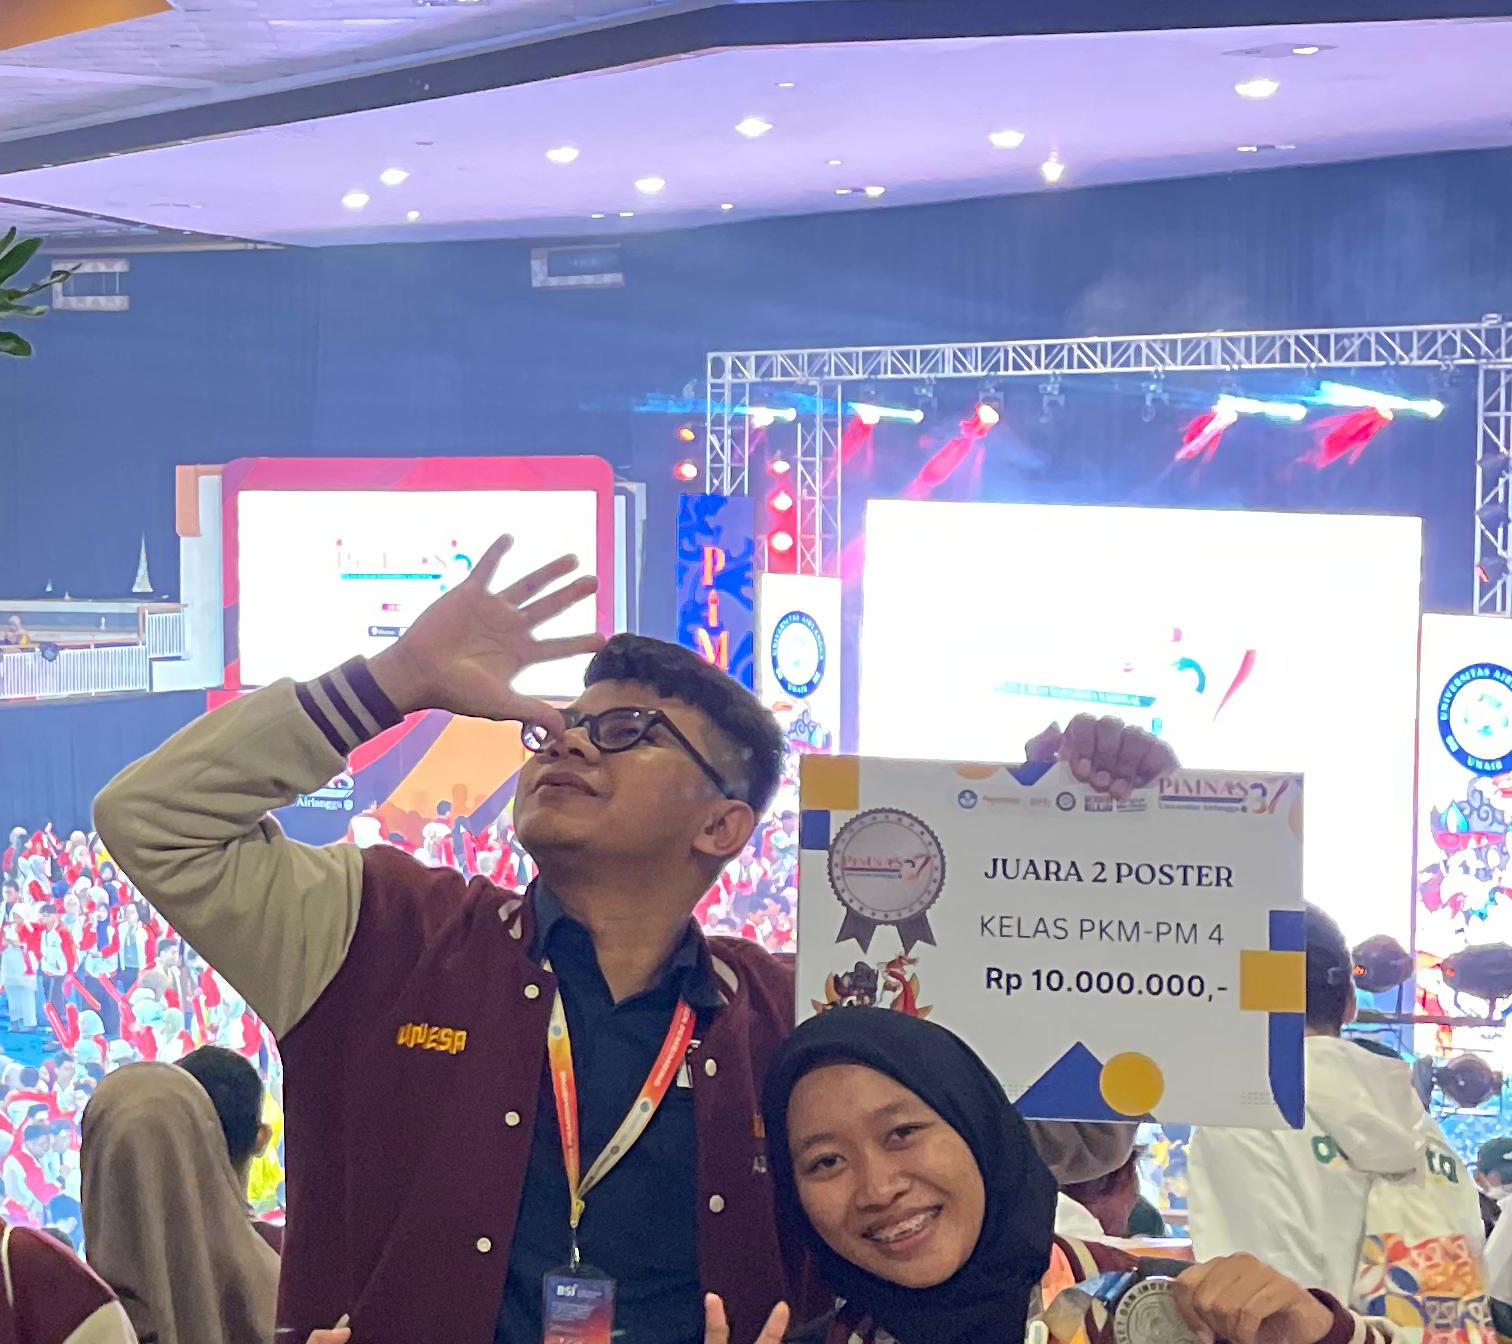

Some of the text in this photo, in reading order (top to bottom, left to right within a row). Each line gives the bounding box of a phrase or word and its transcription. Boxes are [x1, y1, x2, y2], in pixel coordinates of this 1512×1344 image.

[984, 857, 1234, 888] JUARA 2 POSTER
[980, 915, 1225, 945] KELAS PKM-PM 4
[985, 967, 1229, 1003] Rp 10.000.000,-
